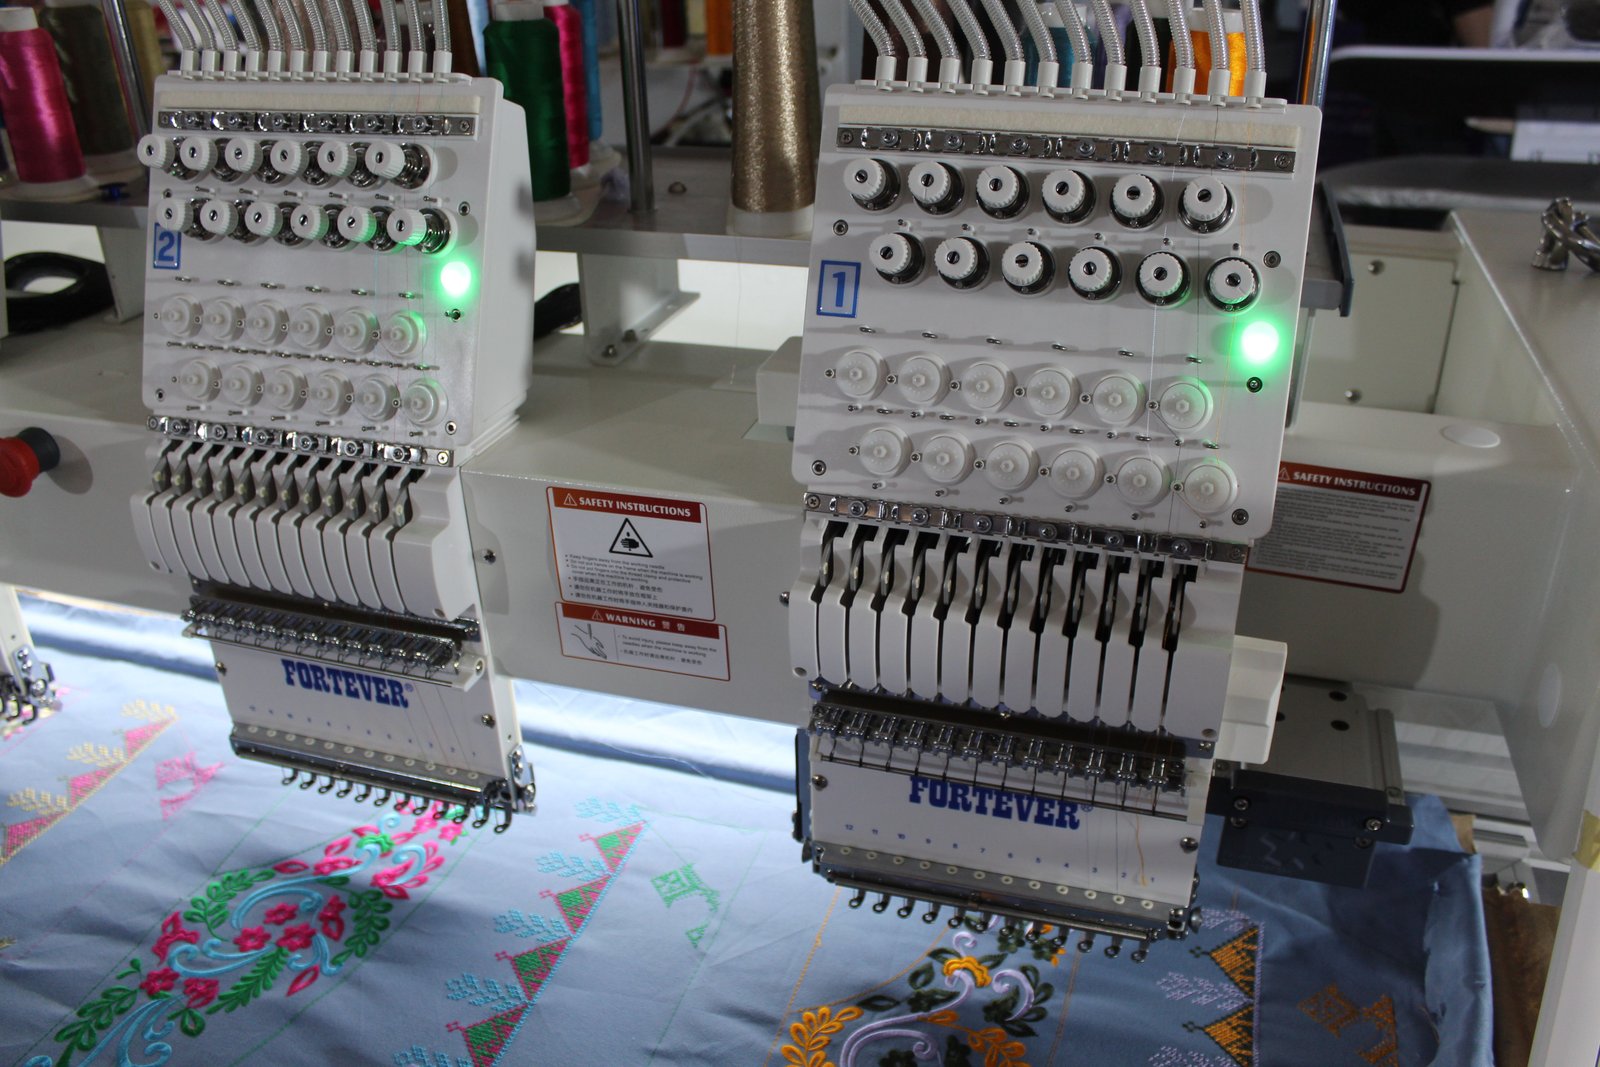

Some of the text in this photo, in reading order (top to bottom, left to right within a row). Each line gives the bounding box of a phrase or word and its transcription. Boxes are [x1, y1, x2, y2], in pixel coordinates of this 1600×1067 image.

[158, 231, 175, 261] 2
[832, 271, 846, 307] 1
[1293, 471, 1416, 496] SAFETY INSTRUCTIONS
[579, 497, 691, 517] SAFETY INSTRUCTIONS
[605, 613, 656, 628] WARNING
